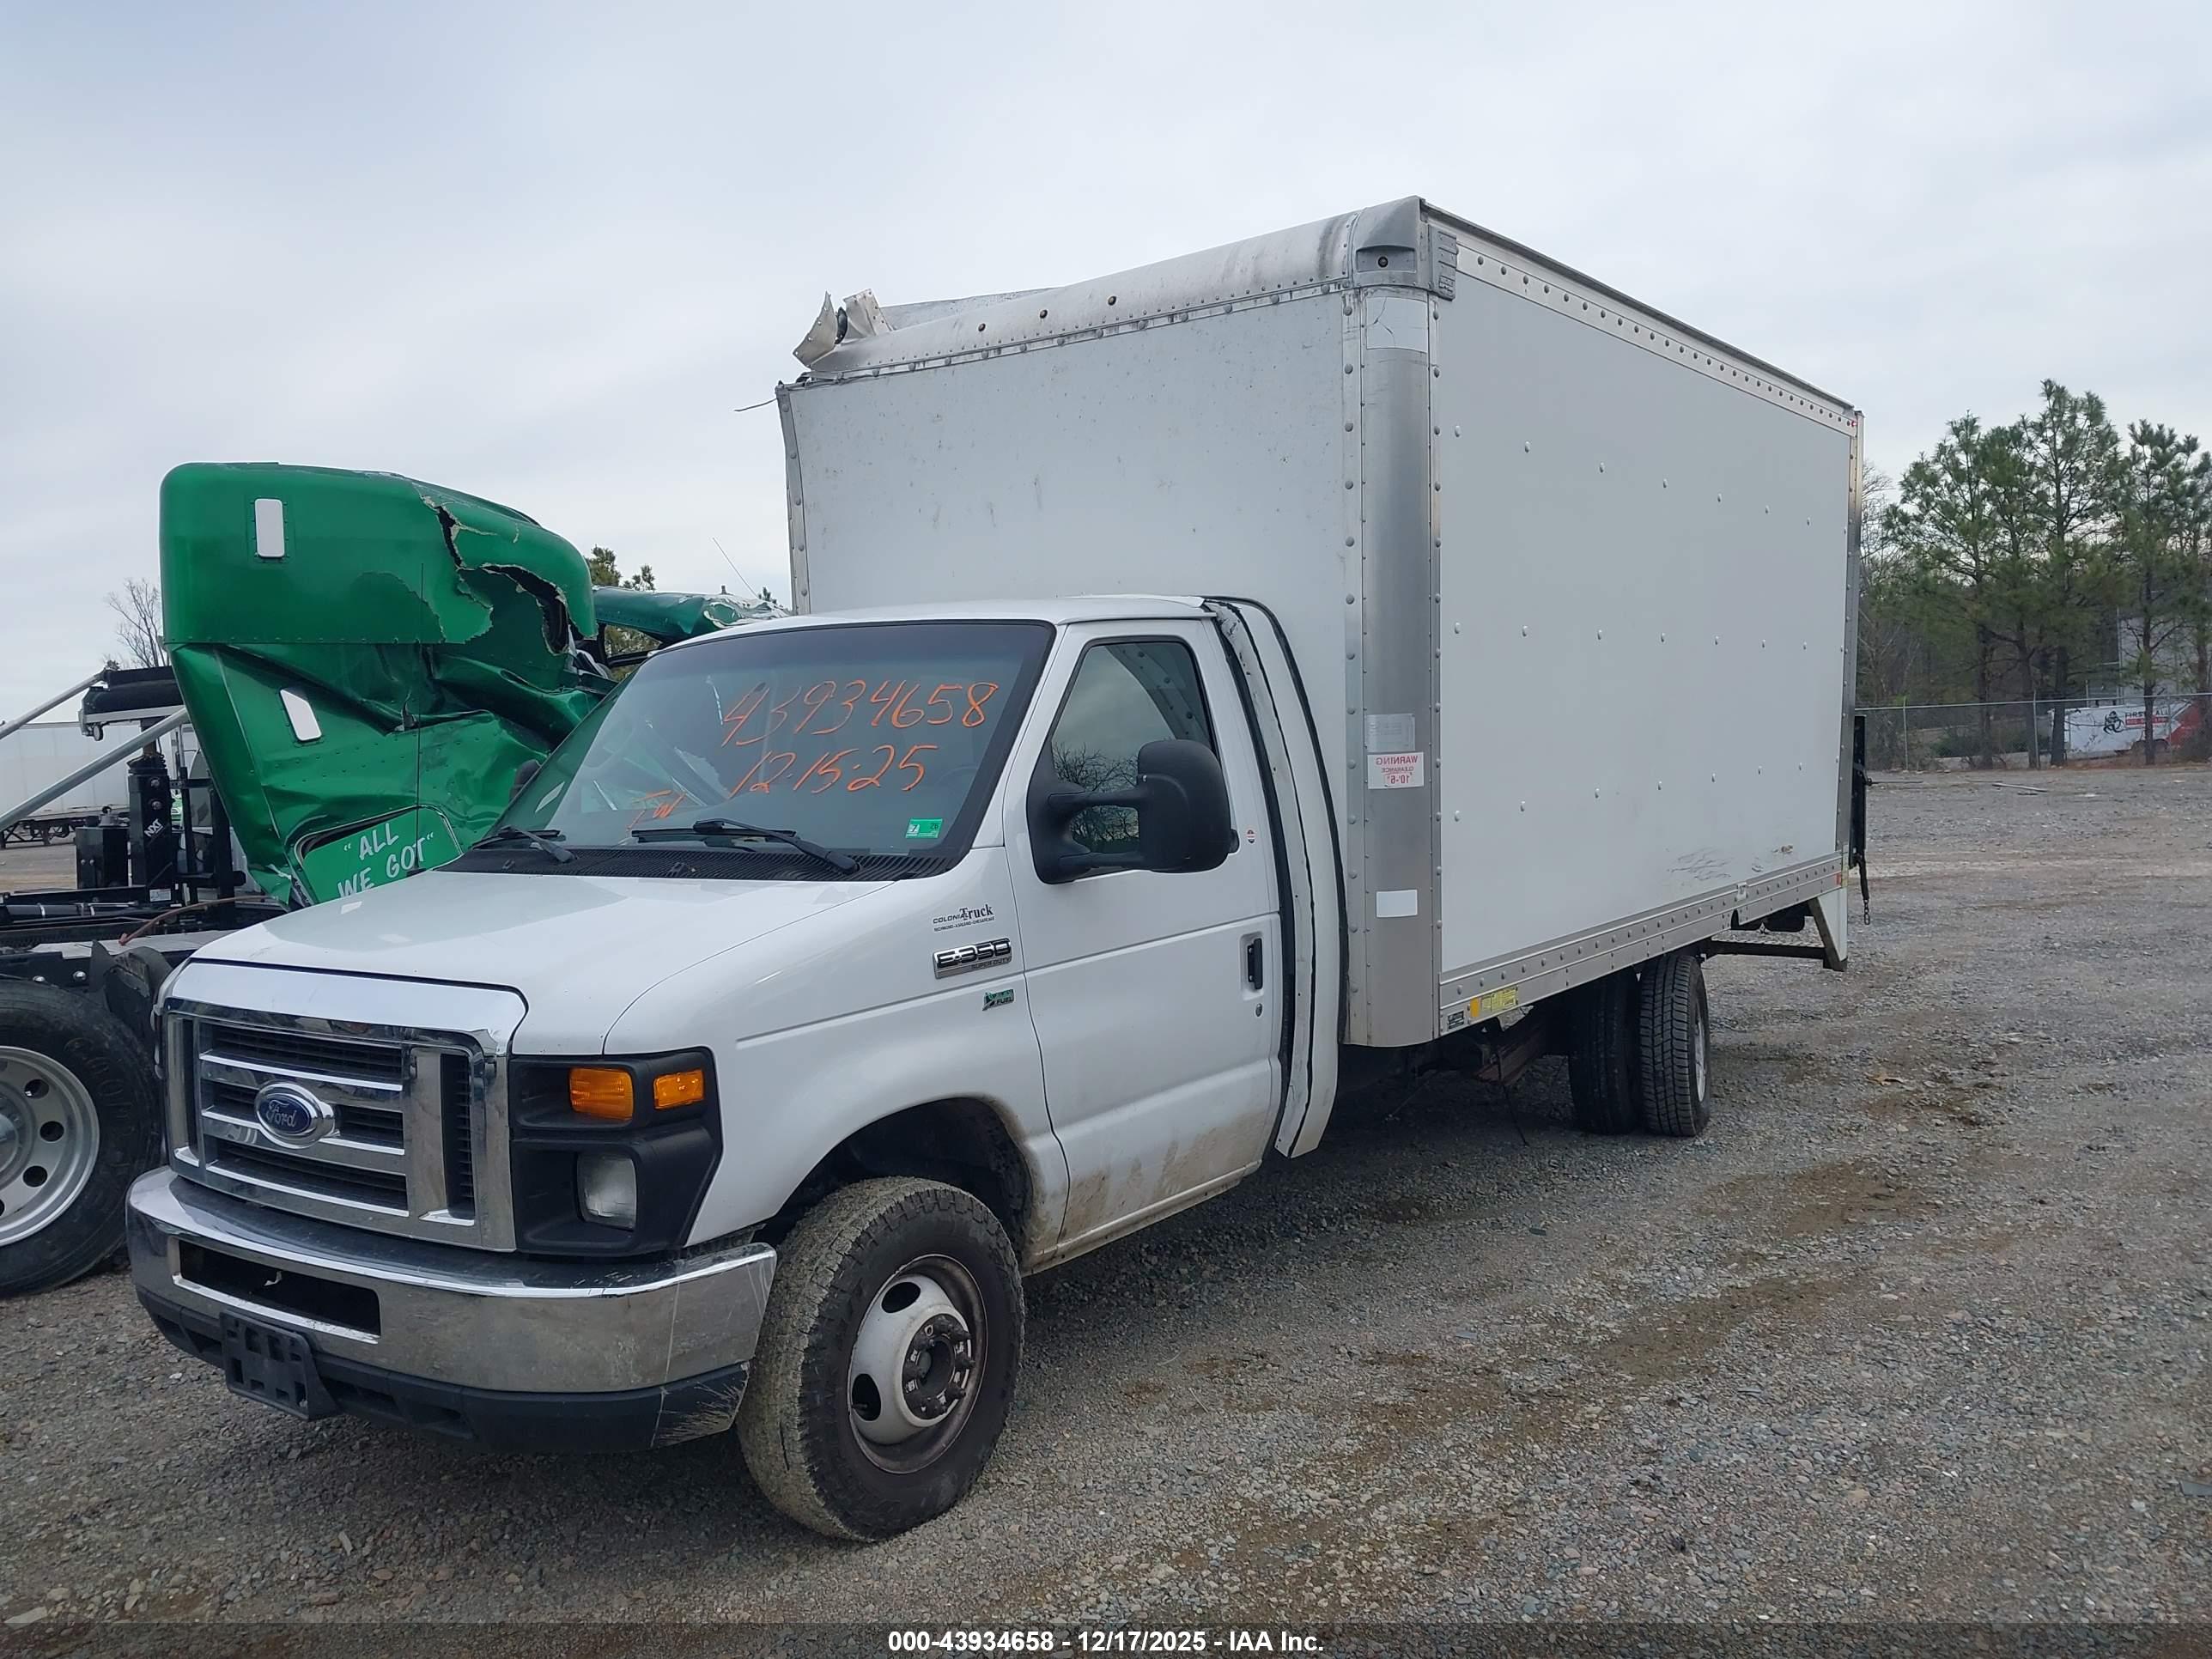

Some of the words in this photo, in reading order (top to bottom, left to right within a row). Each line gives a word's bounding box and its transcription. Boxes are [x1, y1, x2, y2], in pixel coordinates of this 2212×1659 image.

[721, 679, 1000, 747] 43934658
[143, 818, 162, 837] NXT
[337, 866, 375, 898] WE
[959, 904, 994, 921] Truck
[993, 957, 1012, 966] DUTY
[996, 996, 1014, 1005] FUEL
[265, 1099, 297, 1127] Ford
